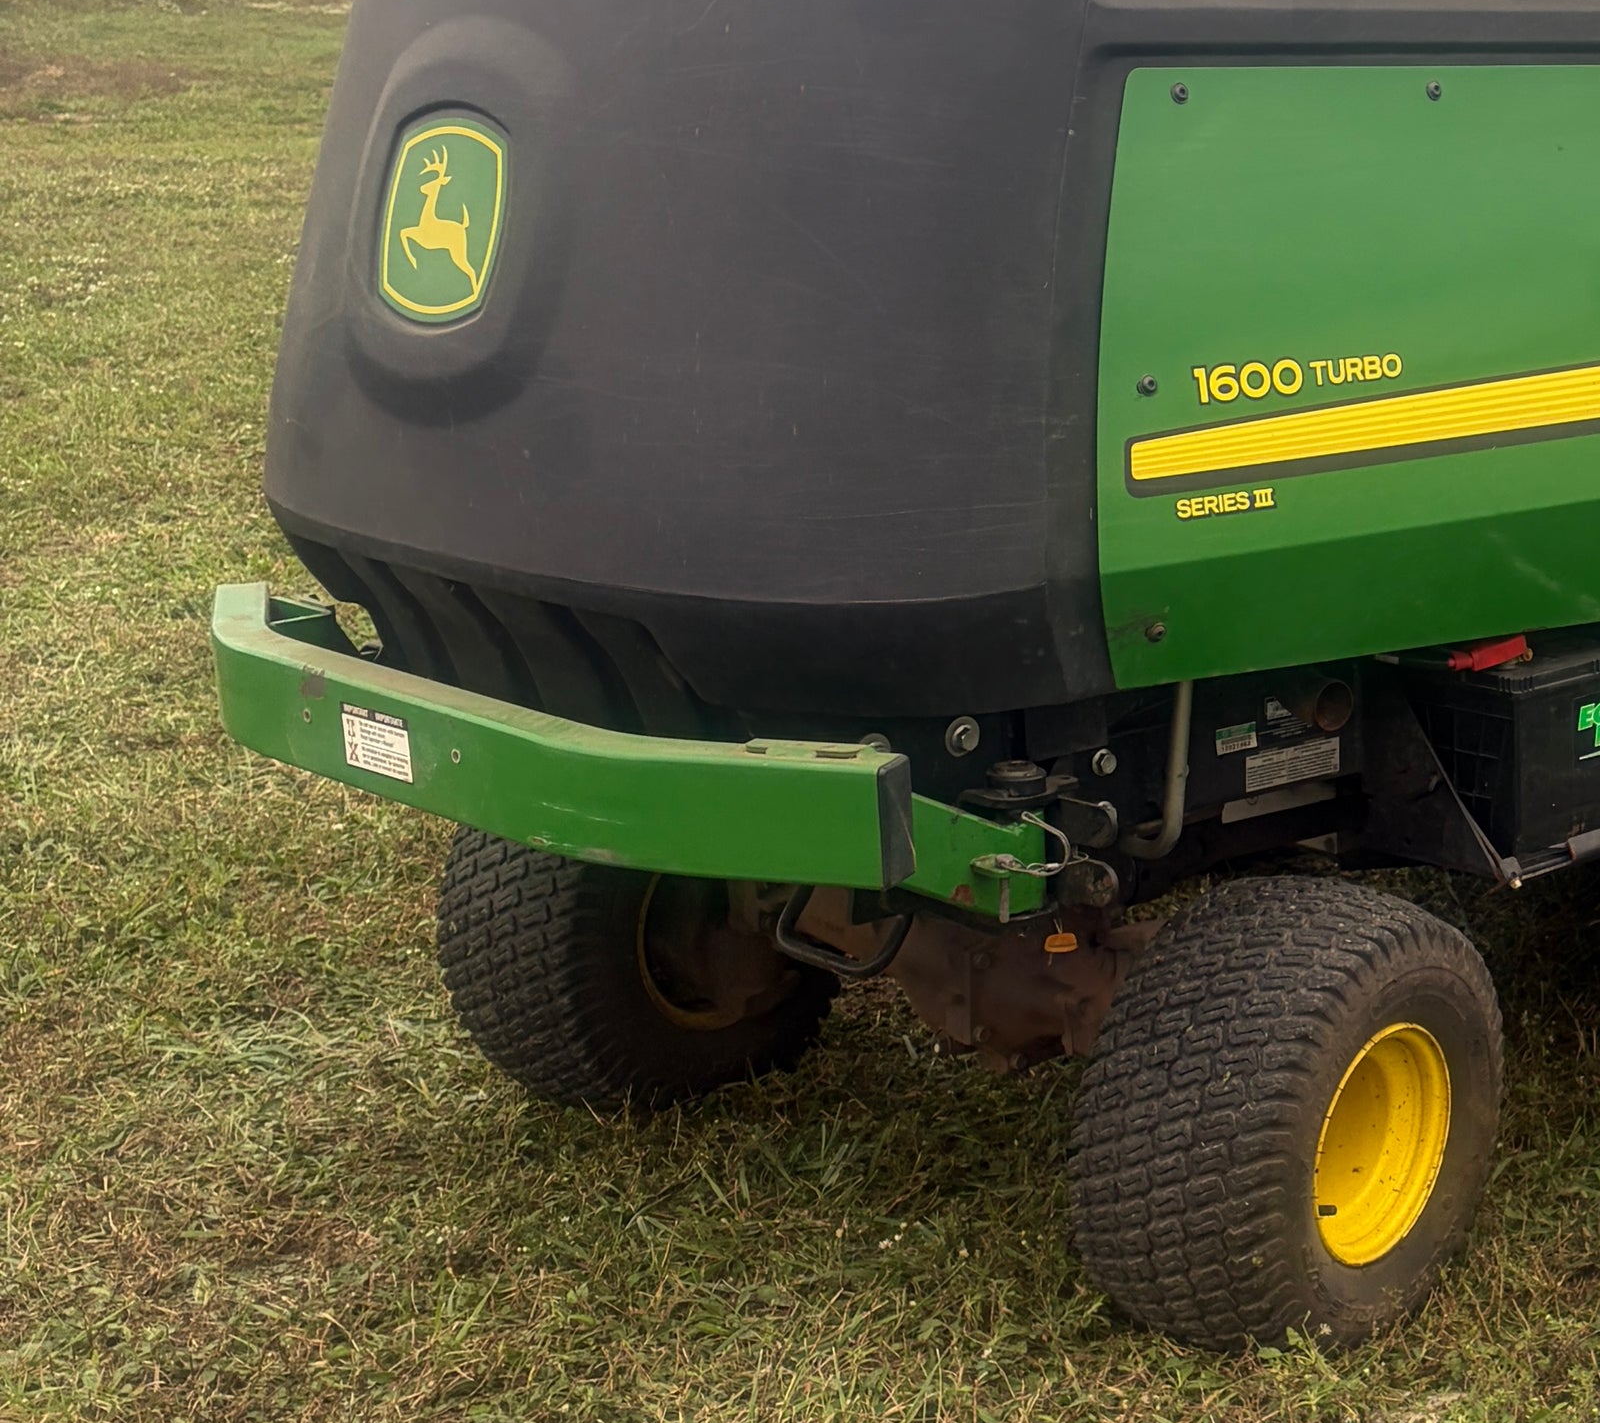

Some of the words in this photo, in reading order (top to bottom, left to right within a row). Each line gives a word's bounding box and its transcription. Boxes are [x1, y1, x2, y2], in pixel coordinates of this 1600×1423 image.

[1192, 358, 1303, 403] 1600
[1309, 353, 1403, 386] TURBO
[1176, 491, 1251, 519] SERIES
[1253, 487, 1275, 509] III
